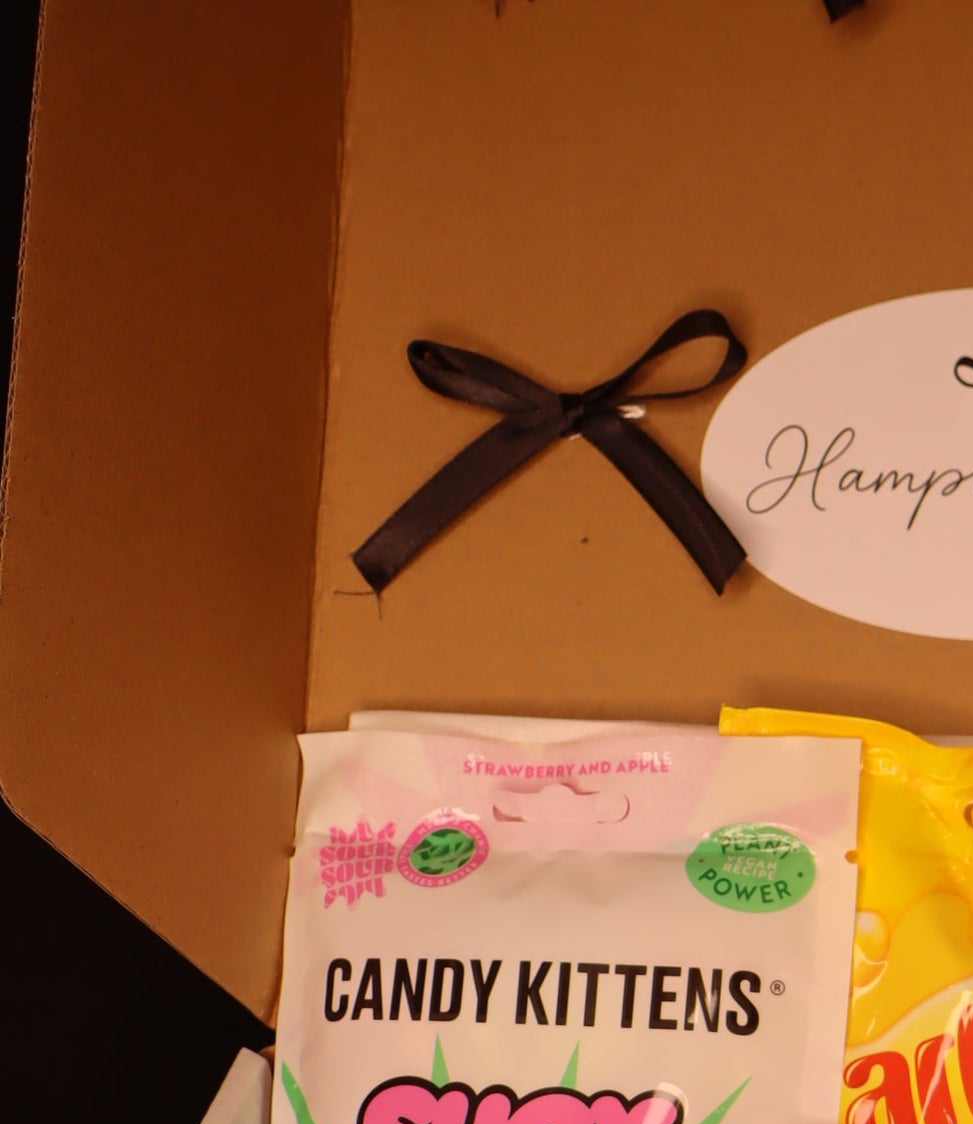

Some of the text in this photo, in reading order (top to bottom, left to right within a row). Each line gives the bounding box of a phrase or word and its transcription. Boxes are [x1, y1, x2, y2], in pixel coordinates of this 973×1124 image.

[463, 759, 669, 778] STRAWBERRY AND APPLE
[723, 863, 775, 880] RECIPE
[727, 855, 777, 869] VEGAN
[698, 868, 792, 903] POWER
[323, 957, 763, 1036] CANDY KITTENS
